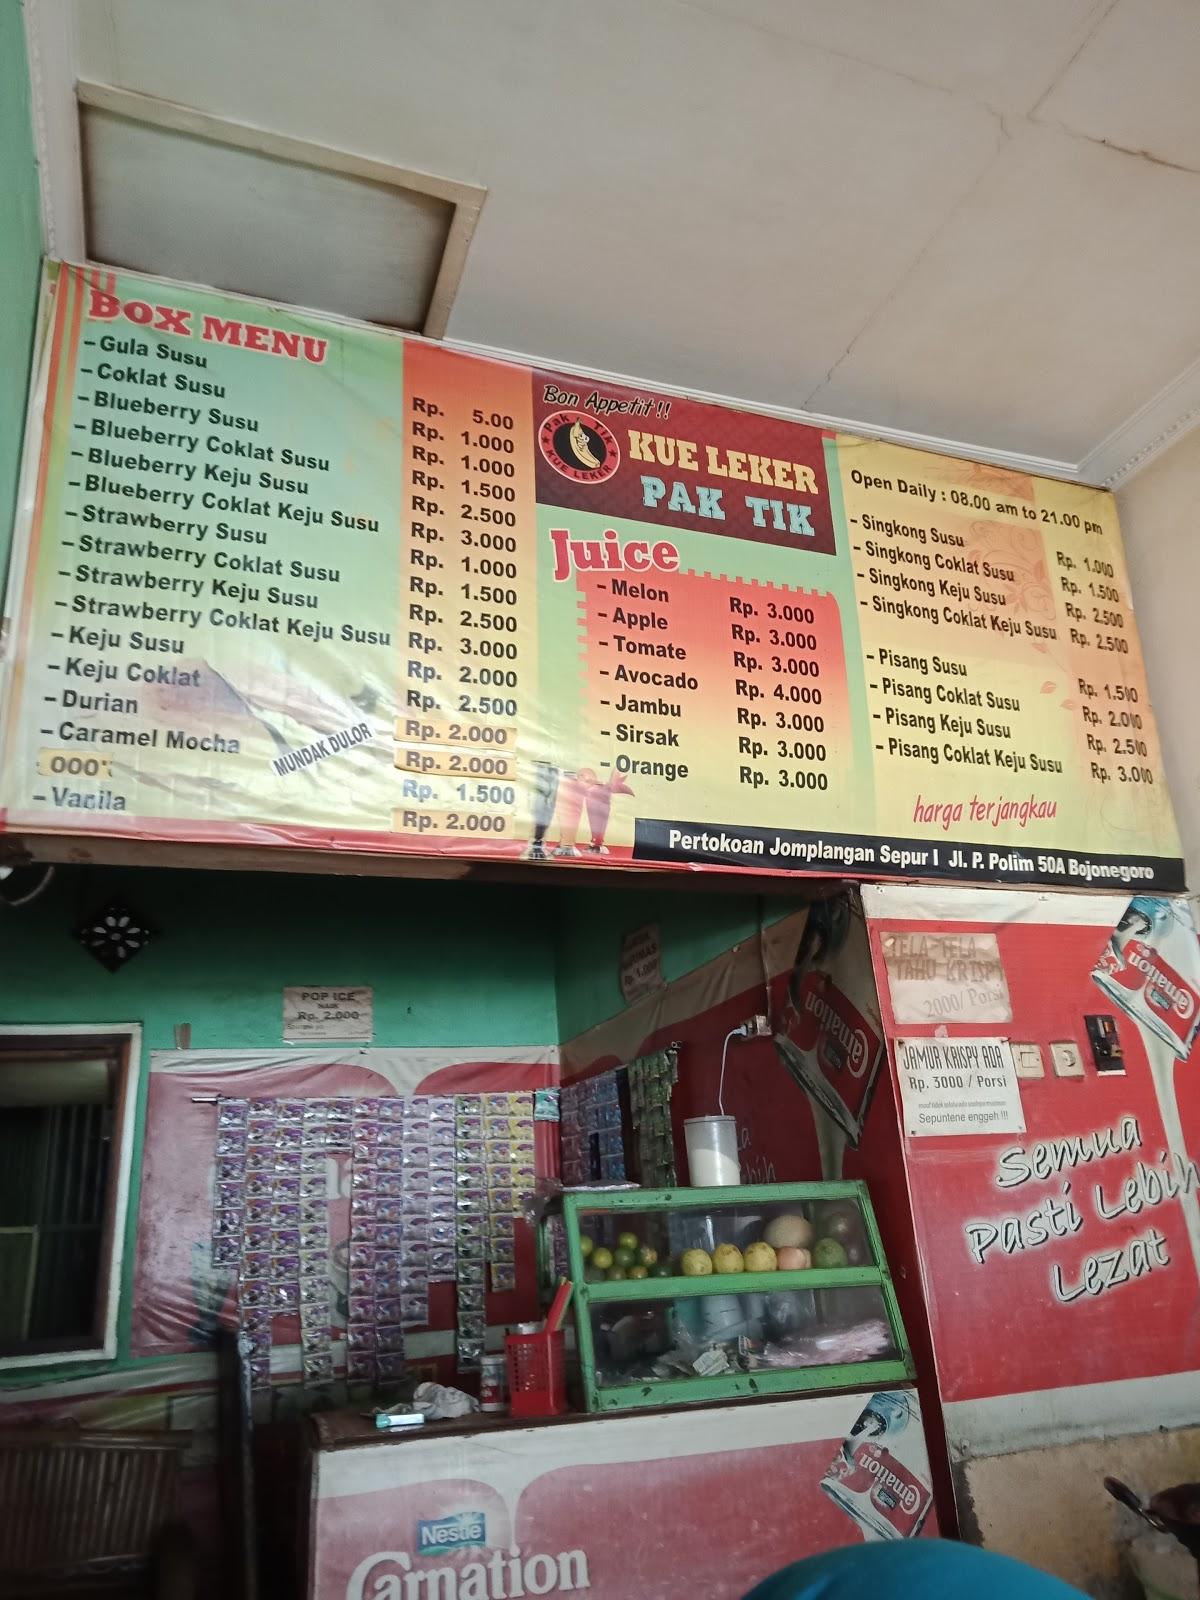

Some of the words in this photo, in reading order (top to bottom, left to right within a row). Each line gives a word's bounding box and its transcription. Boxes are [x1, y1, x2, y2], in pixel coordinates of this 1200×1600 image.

[89, 289, 191, 336] BOX
[202, 315, 328, 364] MENU
[100, 336, 148, 357] Gula
[157, 343, 208, 369] Susu
[98, 363, 167, 388] Coklat
[175, 375, 226, 398] Susu
[94, 391, 200, 424] Blueberry
[209, 408, 259, 432] Susu
[543, 384, 578, 405] Bon
[584, 391, 654, 416] Appetit
[472, 409, 514, 430] 5.00
[91, 420, 198, 452] Blueberry
[207, 436, 274, 463] Coklat
[281, 449, 330, 471] Susu
[461, 431, 514, 454] 1.000
[89, 448, 196, 480] Blueberry
[204, 465, 251, 488] Keju
[259, 472, 309, 494] Susu
[547, 450, 568, 472] KUE
[574, 465, 612, 479] LEKER
[628, 430, 699, 471] KUE
[706, 445, 818, 494] LEKER
[85, 475, 193, 509] Blueberry
[202, 493, 270, 517] Coklat
[278, 503, 323, 525] Keju
[331, 509, 379, 532] Susu
[462, 480, 516, 502] 1.500
[640, 475, 725, 520] PAK
[745, 496, 815, 536] TIK
[851, 470, 892, 490] Open
[898, 478, 936, 502] Daily
[951, 490, 990, 511] 08.00
[996, 502, 1018, 516] am
[1022, 506, 1036, 520] to
[1042, 510, 1080, 529] 21.00
[1084, 520, 1102, 536] pm
[82, 505, 208, 539] Strawberry
[216, 523, 268, 545] Susu
[461, 504, 516, 526] 2.500
[461, 530, 516, 552] 3.000
[551, 530, 680, 582] Juice
[862, 514, 926, 540] Singkong
[931, 528, 964, 548] Susu
[1084, 558, 1114, 578] 1.000
[80, 535, 206, 567] Strawberry
[214, 552, 282, 575] Coklat
[290, 560, 341, 583] Susu
[462, 556, 517, 578] 1.000
[866, 541, 930, 569] Singkong
[935, 557, 978, 575] Coklat
[983, 564, 1014, 582] Susu
[1089, 584, 1119, 602] 1.500
[75, 565, 203, 597] Strawberry
[212, 576, 259, 602] Keju
[268, 587, 319, 609] Susu
[461, 584, 517, 604] 1.500
[612, 579, 669, 602] Melon
[767, 603, 814, 624] 3.000
[870, 568, 935, 596] Singkong
[940, 580, 970, 602] Keju
[974, 587, 1006, 606] Susu
[1093, 608, 1124, 628] 2.500
[72, 596, 200, 627] Strawberry
[209, 608, 279, 633] Coklat
[287, 619, 333, 640] Keju
[341, 624, 391, 646] Susu
[460, 611, 517, 632] 2.500
[613, 608, 668, 630] Apple
[769, 630, 817, 650] 3.000
[873, 596, 939, 624] Singkong
[943, 607, 987, 629] Coklat
[990, 615, 1021, 636] Keju
[1026, 622, 1056, 640] Susu
[1096, 634, 1128, 654] 2.500
[69, 627, 121, 651] Keju
[130, 632, 184, 654] Susu
[460, 638, 517, 660] 3.000
[614, 635, 686, 660] Tomate
[66, 657, 117, 683] Keju
[127, 663, 200, 688] Coklat
[459, 666, 517, 688] 2.000
[615, 665, 698, 690] Avocado
[774, 684, 822, 704] 4.000
[879, 649, 928, 676] Pisang
[933, 656, 967, 676] Susu
[1104, 685, 1138, 703] 1.500
[62, 690, 138, 714] Durian
[458, 695, 517, 716] 2.500
[616, 694, 681, 717] Jambu
[776, 712, 824, 732] 3.000
[882, 677, 931, 704] Pisang
[937, 686, 982, 706] Coklat
[987, 693, 1020, 711] Susu
[1108, 711, 1142, 729] 2.000
[59, 722, 158, 747] Caramel
[166, 730, 241, 754] Mocha
[448, 725, 508, 744] 2.000
[616, 724, 679, 746] Sirsak
[886, 707, 935, 733] Pisang
[940, 714, 972, 735] Keju
[977, 720, 1011, 739] Susu
[273, 741, 329, 776] MUNDAK
[329, 722, 372, 752] DULOR
[448, 756, 508, 776] 2.000
[889, 738, 938, 764] Pisang
[944, 744, 990, 766] Coklat
[995, 750, 1025, 772] Keju
[1030, 755, 1062, 773] Susu
[1118, 766, 1153, 784] 3.000
[616, 755, 689, 781] Orange
[779, 770, 828, 790] 3.000
[52, 787, 127, 811] Vanila
[456, 784, 515, 804] 1.500
[446, 814, 505, 832] 2.000
[913, 795, 961, 831] harga
[970, 795, 1057, 827] terjangkau
[669, 830, 764, 854] Pertokoan
[769, 837, 875, 865] Jomplangan
[880, 845, 928, 866] Sepur
[949, 851, 967, 868] Jl.
[972, 852, 984, 869] P.
[989, 854, 1034, 873] Polim
[1038, 856, 1065, 874] 50A
[1069, 860, 1154, 881] Bojonegoro
[302, 992, 329, 1000] POP
[333, 992, 355, 1000] ICE
[904, 1046, 942, 1070] JAMUR
[943, 1046, 979, 1070] KRISPY
[983, 1046, 1004, 1069] ADA
[910, 1077, 929, 1091] Rp.
[934, 1076, 963, 1088] 3000
[977, 1075, 1006, 1088] Porsi
[919, 1113, 965, 1124] Sepuntene
[968, 1112, 998, 1123] enggeh
[996, 1116, 1143, 1188] Semua
[965, 1181, 1083, 1264] Pasti
[1095, 1151, 1200, 1219] Lebih
[1053, 1229, 1170, 1302] Lezat
